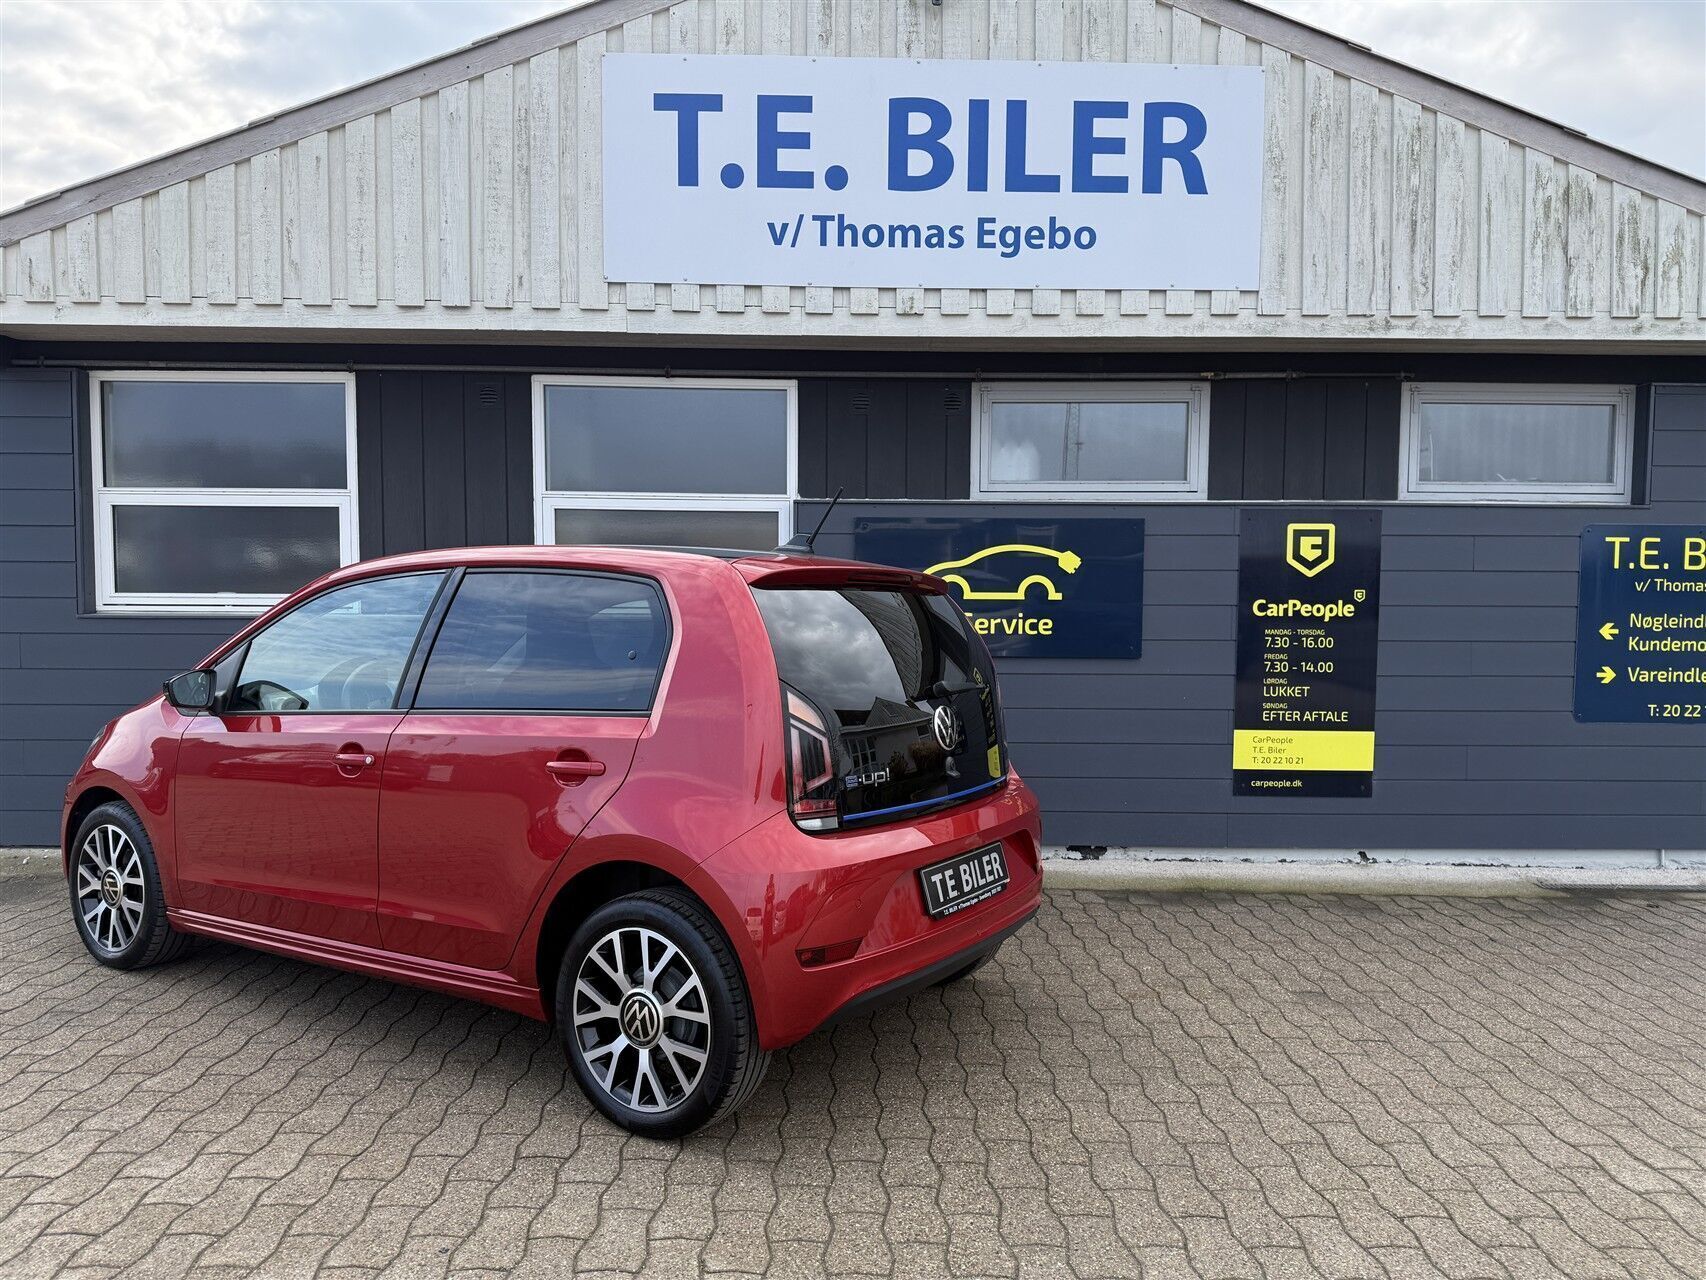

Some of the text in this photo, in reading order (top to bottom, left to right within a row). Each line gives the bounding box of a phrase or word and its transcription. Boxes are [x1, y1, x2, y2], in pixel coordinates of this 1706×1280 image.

[653, 92, 1208, 195] T.E. BILER
[767, 213, 1097, 258] v/ Thomas Egebo
[1605, 536, 1706, 571] T.E. B
[1635, 578, 1706, 592] v/ Thoma
[1252, 599, 1355, 622] CarPeople
[964, 612, 1053, 635] ervice
[1629, 613, 1706, 632] Nøgleind
[1264, 636, 1290, 648] 7.30
[1301, 636, 1334, 648] 16.00
[1263, 661, 1289, 673] 7.30
[1300, 661, 1334, 673] 14.00
[1263, 686, 1310, 697] LUKKET
[1262, 710, 1349, 722] EFTER AFTALE
[1648, 704, 1660, 717] T:
[1663, 704, 1681, 717] 20
[1684, 704, 1701, 717] 22
[1252, 735, 1294, 745] CarPeople
[1268, 746, 1287, 754] Biler
[1252, 756, 1259, 764] T:
[1273, 757, 1283, 765] 22
[1285, 757, 1294, 765] 10
[1295, 757, 1304, 765] 21
[1251, 779, 1303, 788] carpeople.dk
[959, 852, 1004, 893] BILER
